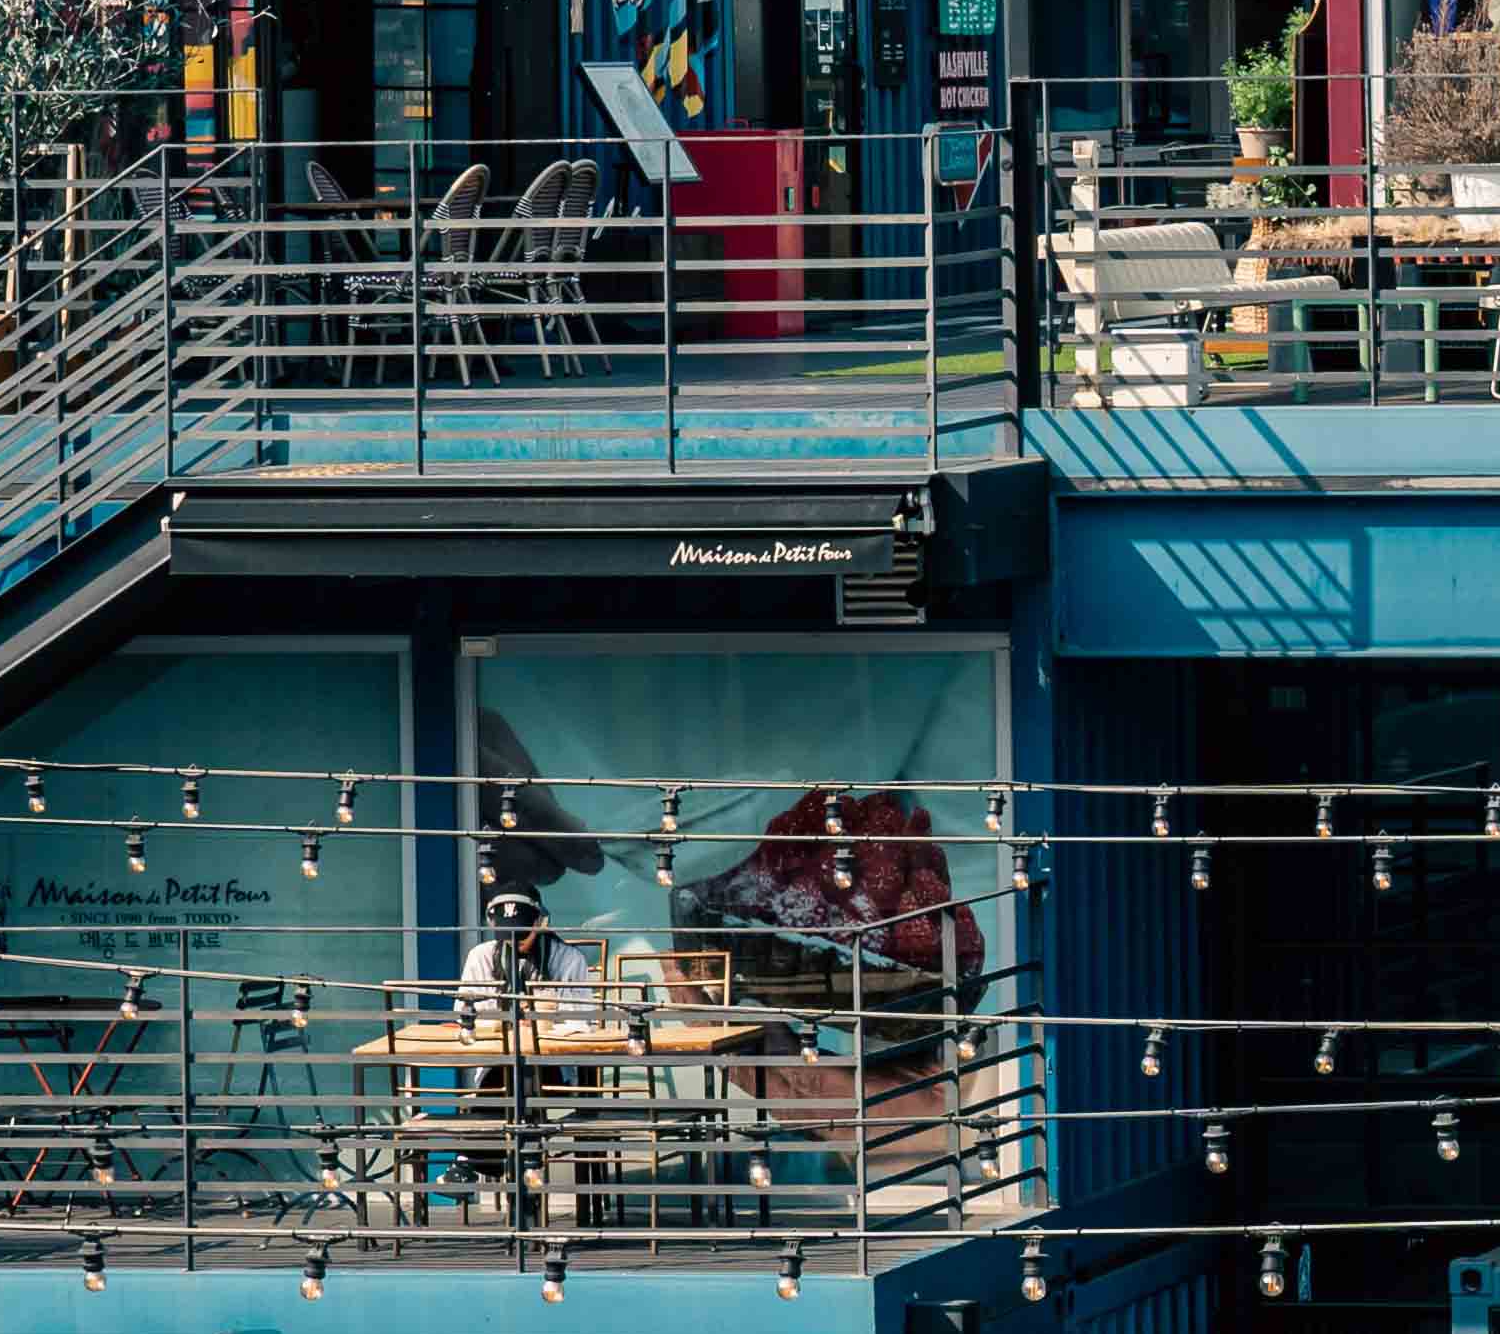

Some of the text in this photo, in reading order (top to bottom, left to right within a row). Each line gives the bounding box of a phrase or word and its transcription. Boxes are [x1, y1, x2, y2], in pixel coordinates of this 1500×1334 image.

[939, 50, 989, 79] NASHVILLE
[939, 84, 990, 109] HOT CHICKEN
[669, 541, 758, 566] Maison
[773, 541, 815, 563] Petit
[817, 542, 853, 563] Four
[27, 876, 141, 907] Maison
[165, 877, 219, 904] Petit
[224, 878, 272, 903] Four
[70, 912, 231, 924] SINCE 1990 from TOKYO
